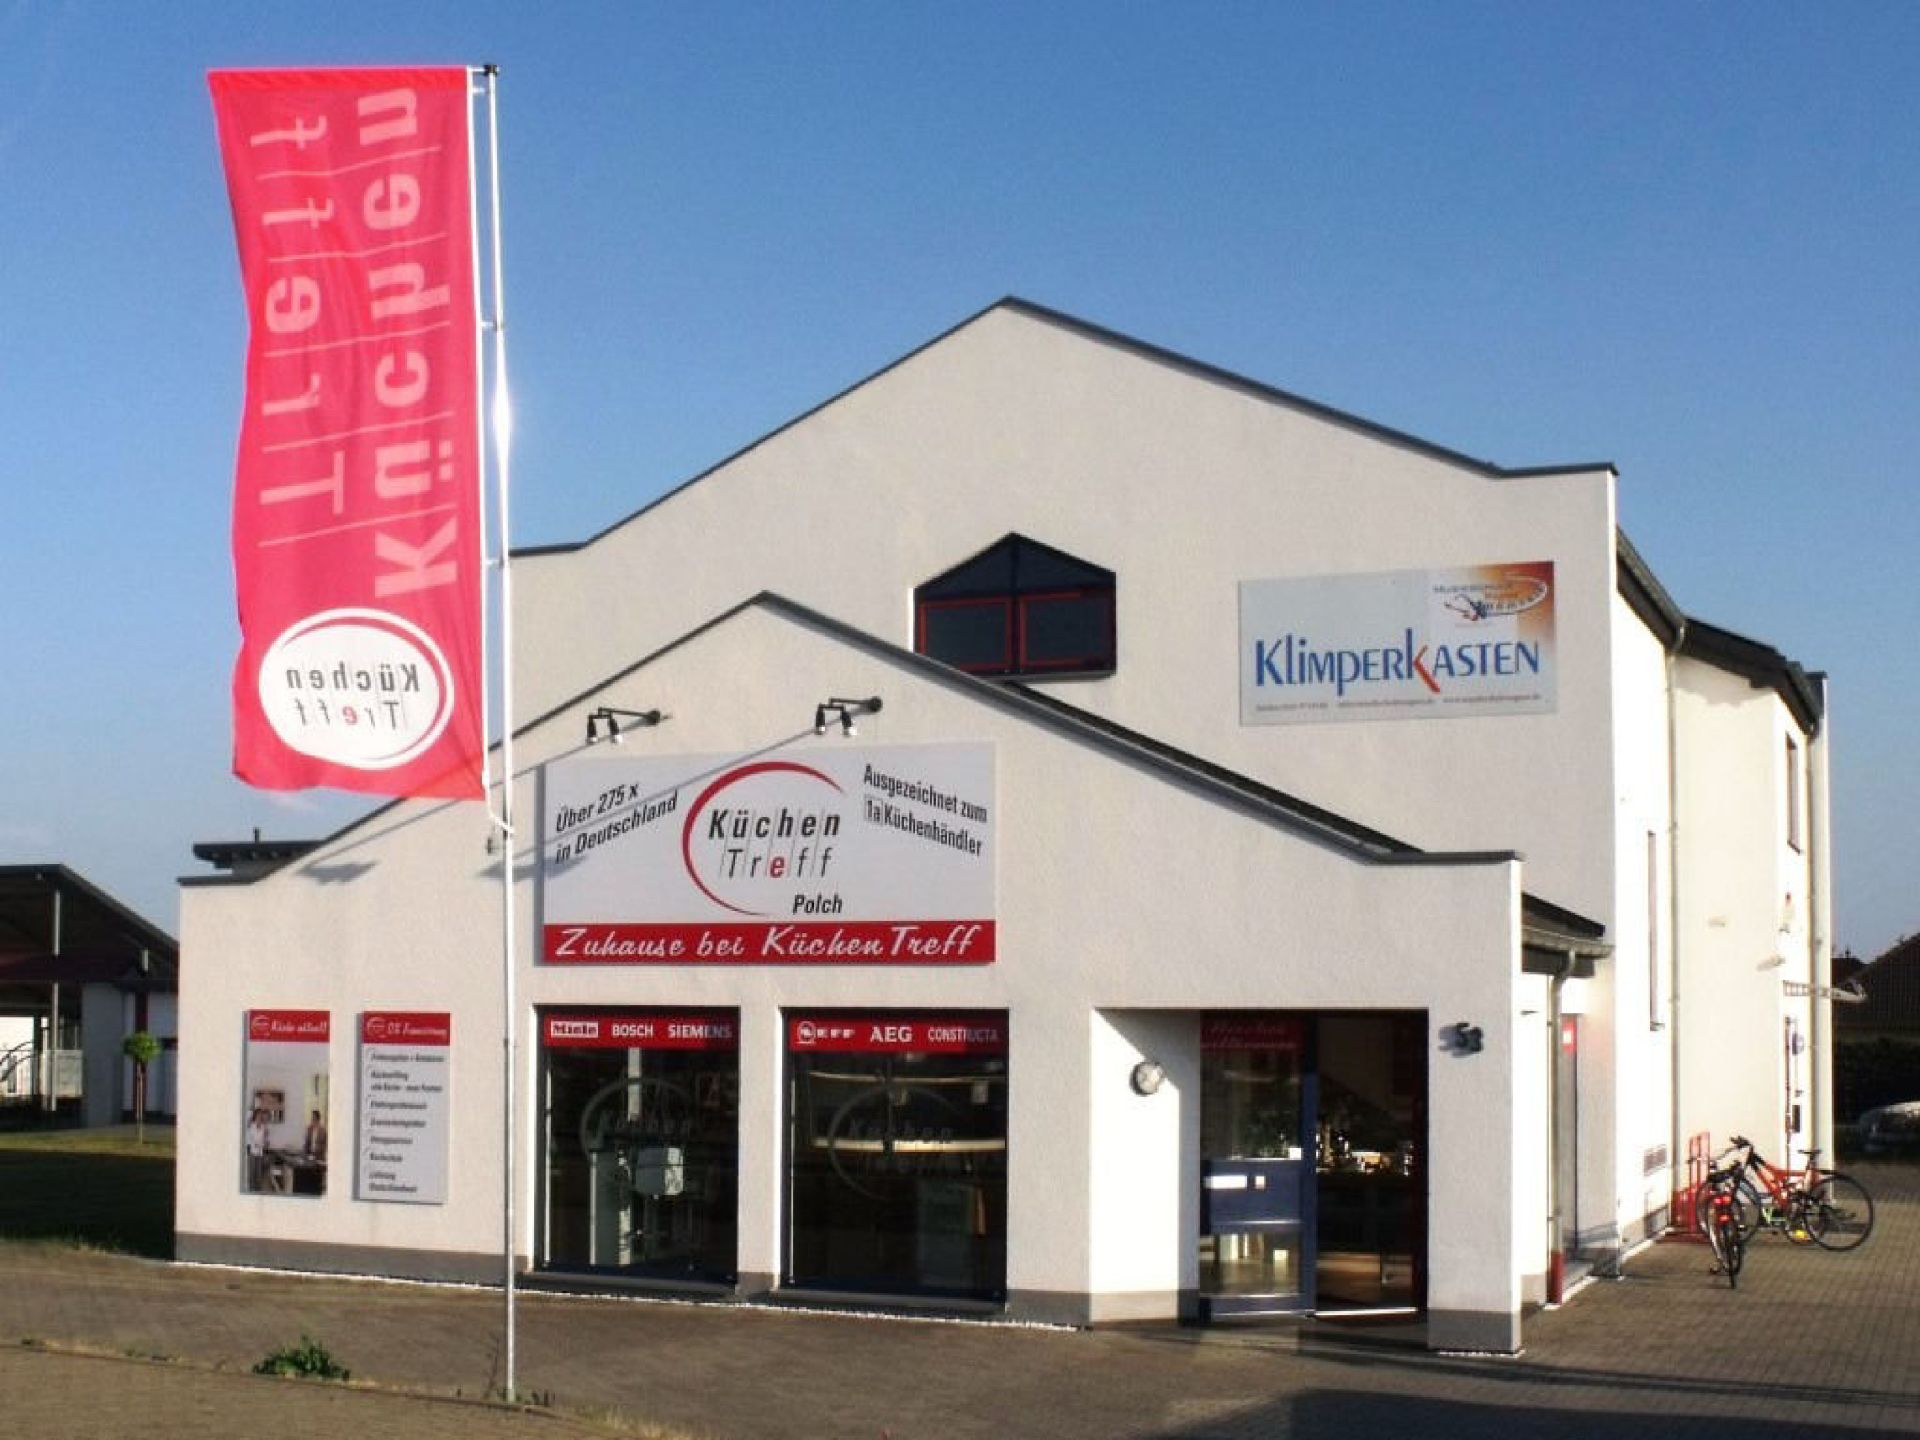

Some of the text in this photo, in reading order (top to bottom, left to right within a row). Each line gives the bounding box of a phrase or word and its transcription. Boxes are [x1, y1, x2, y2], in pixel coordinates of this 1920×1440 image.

[555, 804, 595, 833] Über
[597, 784, 626, 814] 275
[863, 763, 988, 824] Ausgezeichnet zum
[555, 787, 679, 865] in Deutschland
[708, 807, 841, 840] Küchen
[727, 847, 833, 879] Treff
[792, 893, 843, 915] Polch
[555, 928, 686, 957] Zuhause
[696, 930, 745, 957] bei
[611, 1023, 654, 1037] BOSCH
[667, 1023, 733, 1039] SIEMENS
[870, 1026, 913, 1043] AEG
